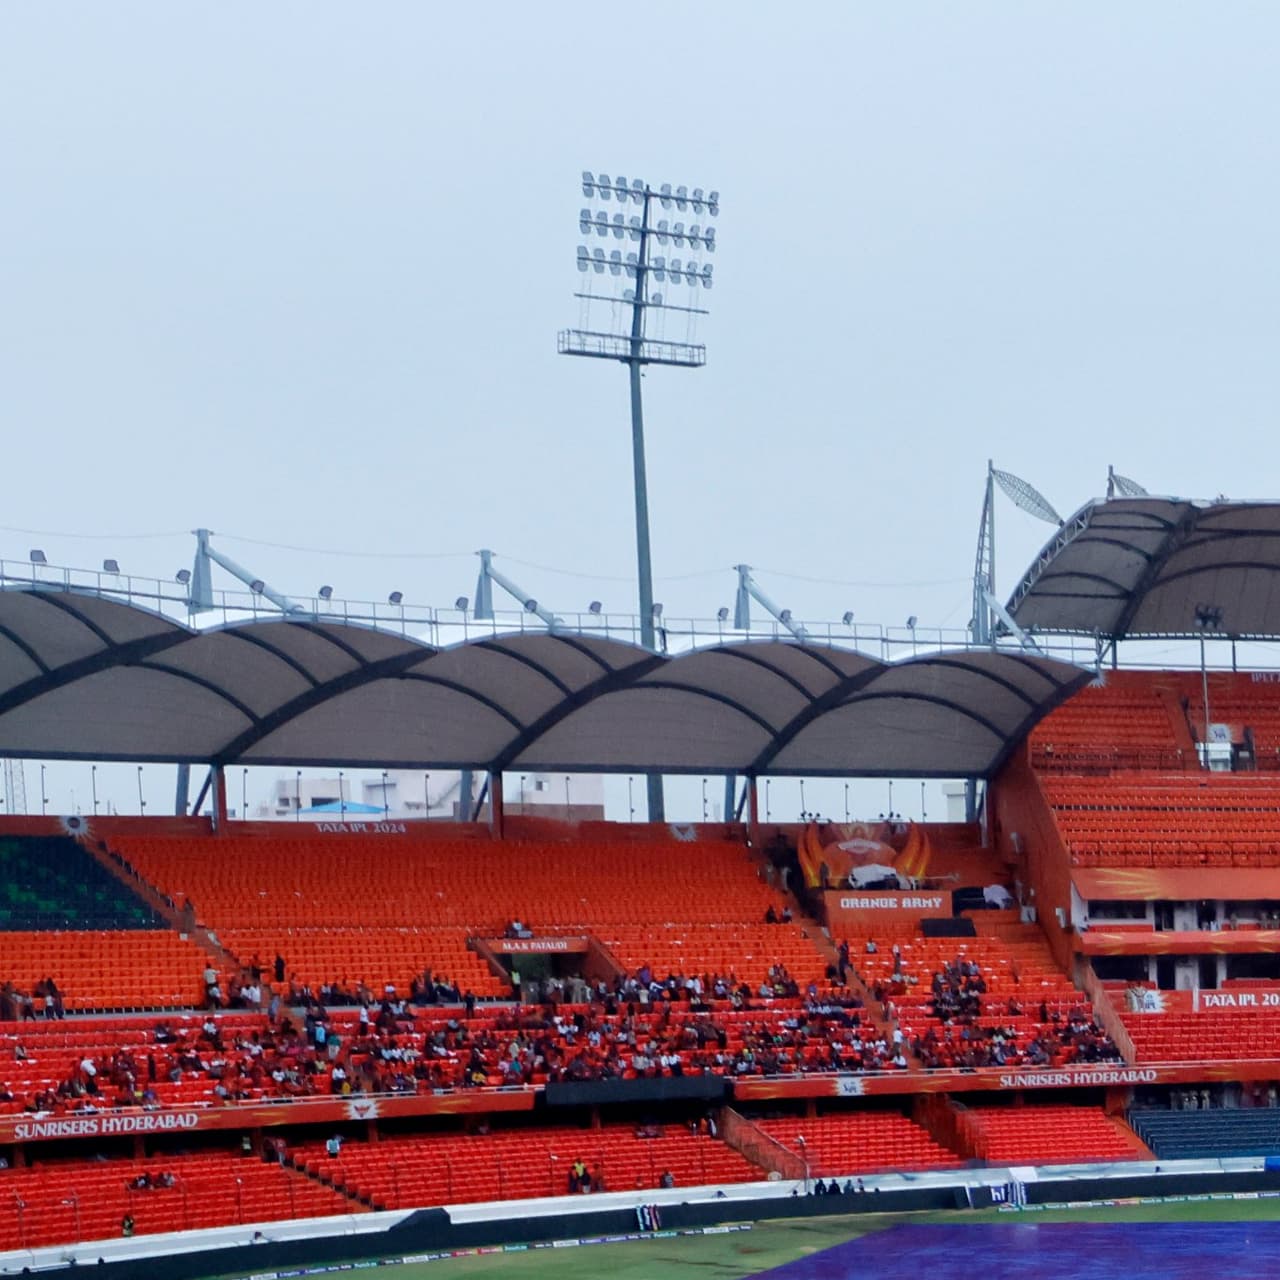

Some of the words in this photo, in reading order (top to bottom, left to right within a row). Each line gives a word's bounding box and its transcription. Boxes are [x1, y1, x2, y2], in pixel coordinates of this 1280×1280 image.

[315, 822, 349, 833] TATA
[374, 822, 407, 833] 2024
[841, 897, 898, 909] ORANGE
[902, 897, 942, 909] ARMY
[1203, 994, 1235, 1007] TATA
[1238, 993, 1259, 1006] IPL
[999, 1073, 1072, 1088] SUNRISERS
[1074, 1070, 1158, 1084] HYDERABAD
[14, 1118, 99, 1140] SUNRISERS
[101, 1112, 199, 1133] HYDERABAD
